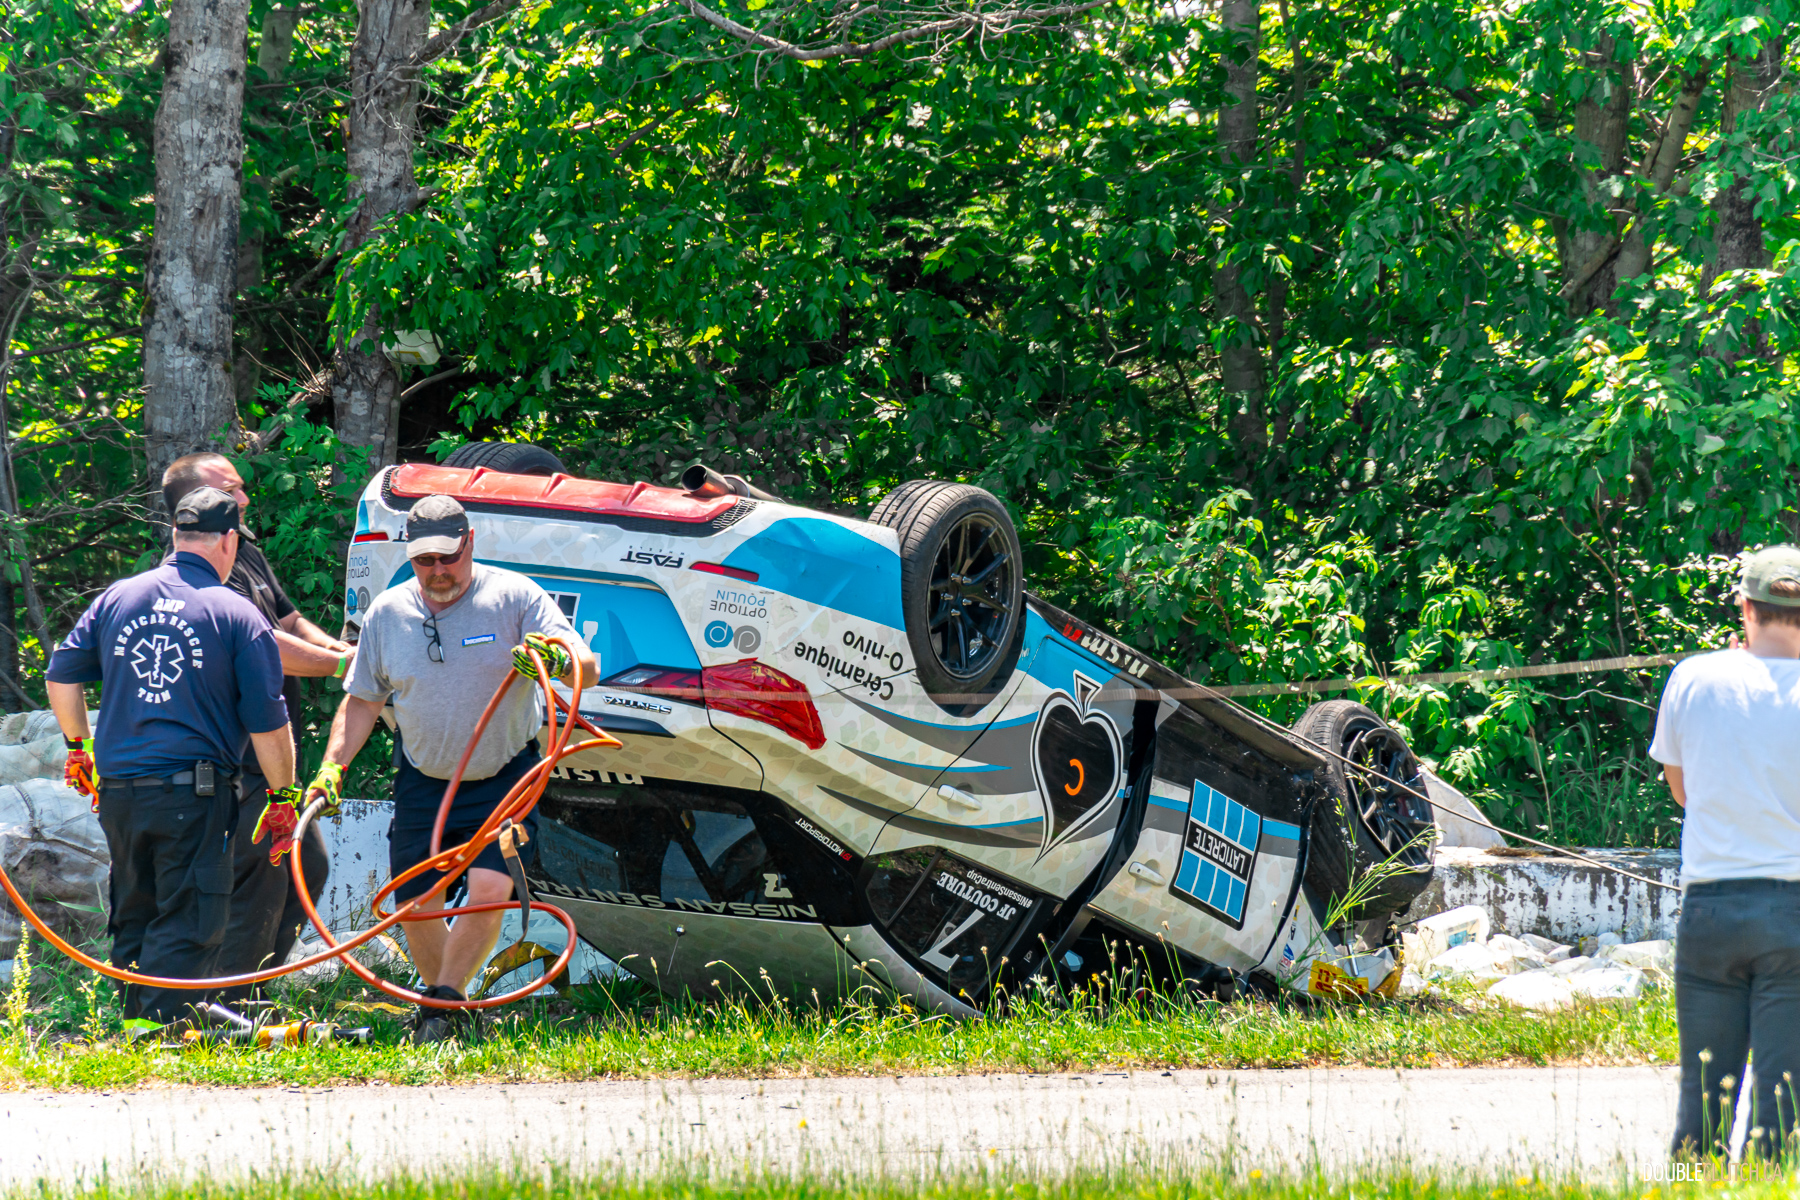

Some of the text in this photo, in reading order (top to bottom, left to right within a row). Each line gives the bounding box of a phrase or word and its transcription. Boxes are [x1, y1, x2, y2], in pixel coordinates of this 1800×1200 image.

[619, 550, 684, 569] FAST
[152, 597, 186, 613] AMP
[709, 600, 767, 619] OPTIQUE
[716, 589, 766, 606] POULIN
[114, 613, 203, 669] MEDICAL RESCUE
[843, 630, 904, 671] O-nivo
[794, 641, 894, 701] Céramique
[137, 687, 171, 704] TEAM
[602, 694, 672, 714] SENTRA
[1064, 758, 1085, 796] C
[1192, 828, 1246, 875] LATICRETE
[527, 876, 818, 918] NISSAN SENTRA
[936, 871, 1017, 921] JF COUTURE
[966, 869, 1034, 909] #NissanSentraCup
[919, 908, 985, 973] 7
